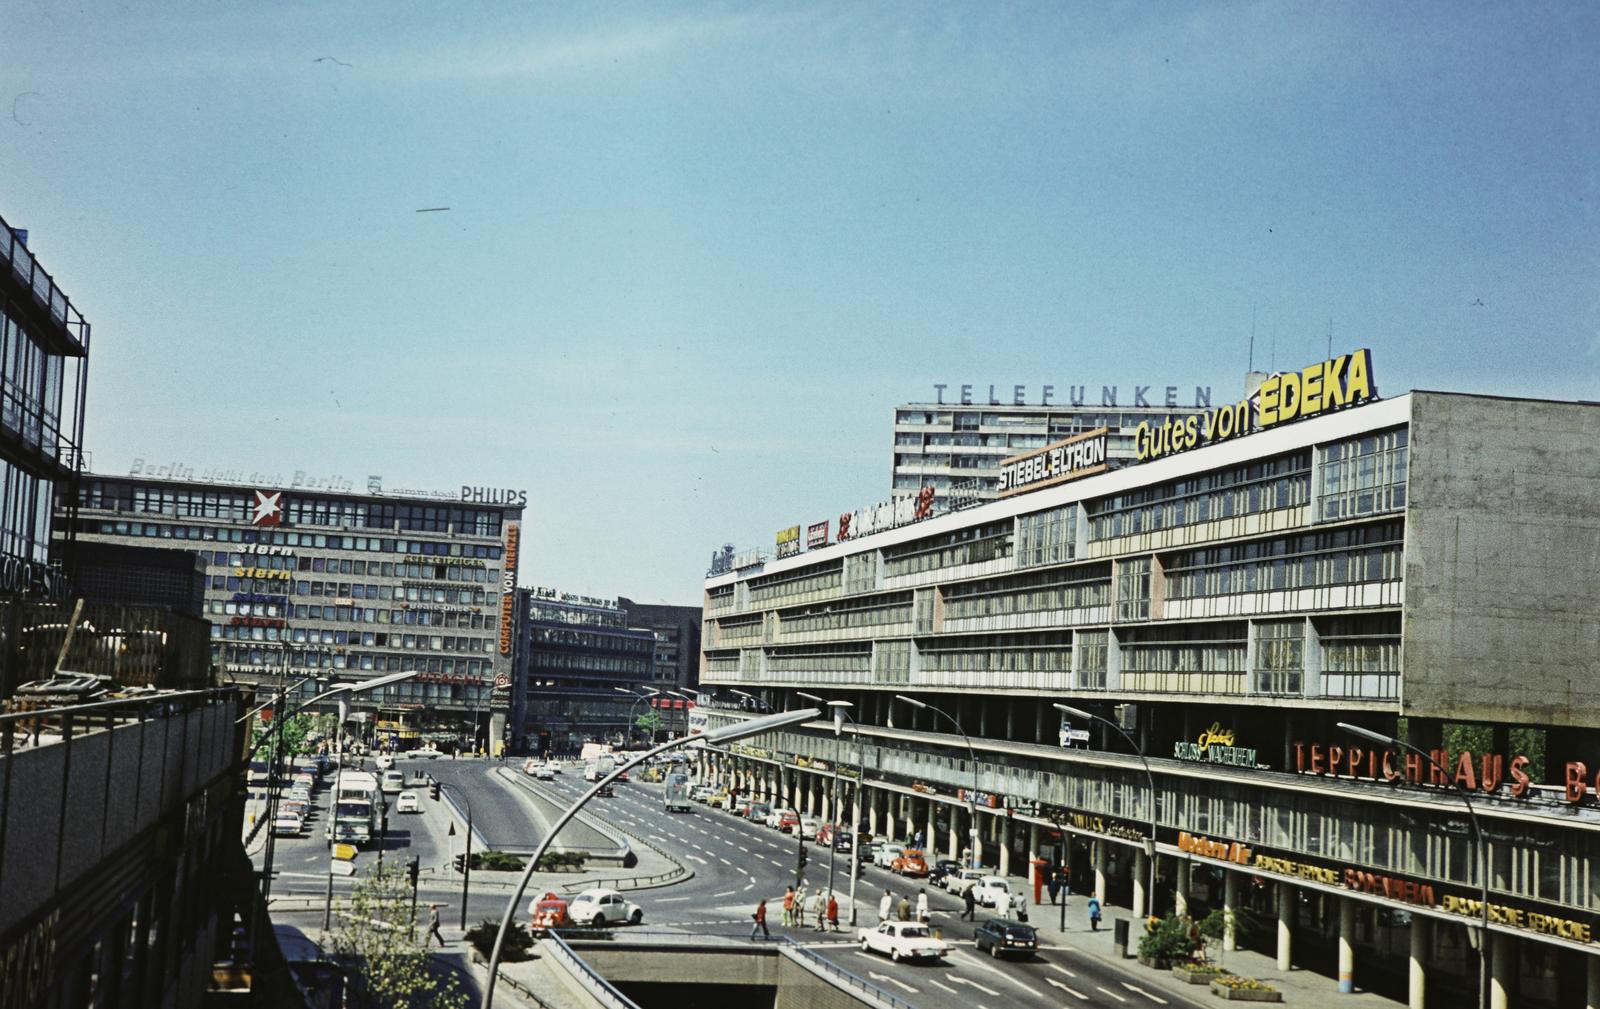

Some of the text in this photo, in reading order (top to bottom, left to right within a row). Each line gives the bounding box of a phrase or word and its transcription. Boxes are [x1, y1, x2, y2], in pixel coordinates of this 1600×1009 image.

[934, 384, 1212, 407] TELEFUNKEN
[1135, 348, 1373, 461] Gutes von EDEKA
[130, 458, 194, 479] Berlin
[291, 470, 353, 491] Berlin
[996, 436, 1105, 491] STIEBEL ELTRON
[461, 485, 527, 506] PHILIPS
[236, 543, 293, 556] stern
[233, 567, 291, 580] stern
[500, 523, 518, 656] COMPUTER VON KIENZLE
[1294, 742, 1530, 797] TEPPICHHAUS
